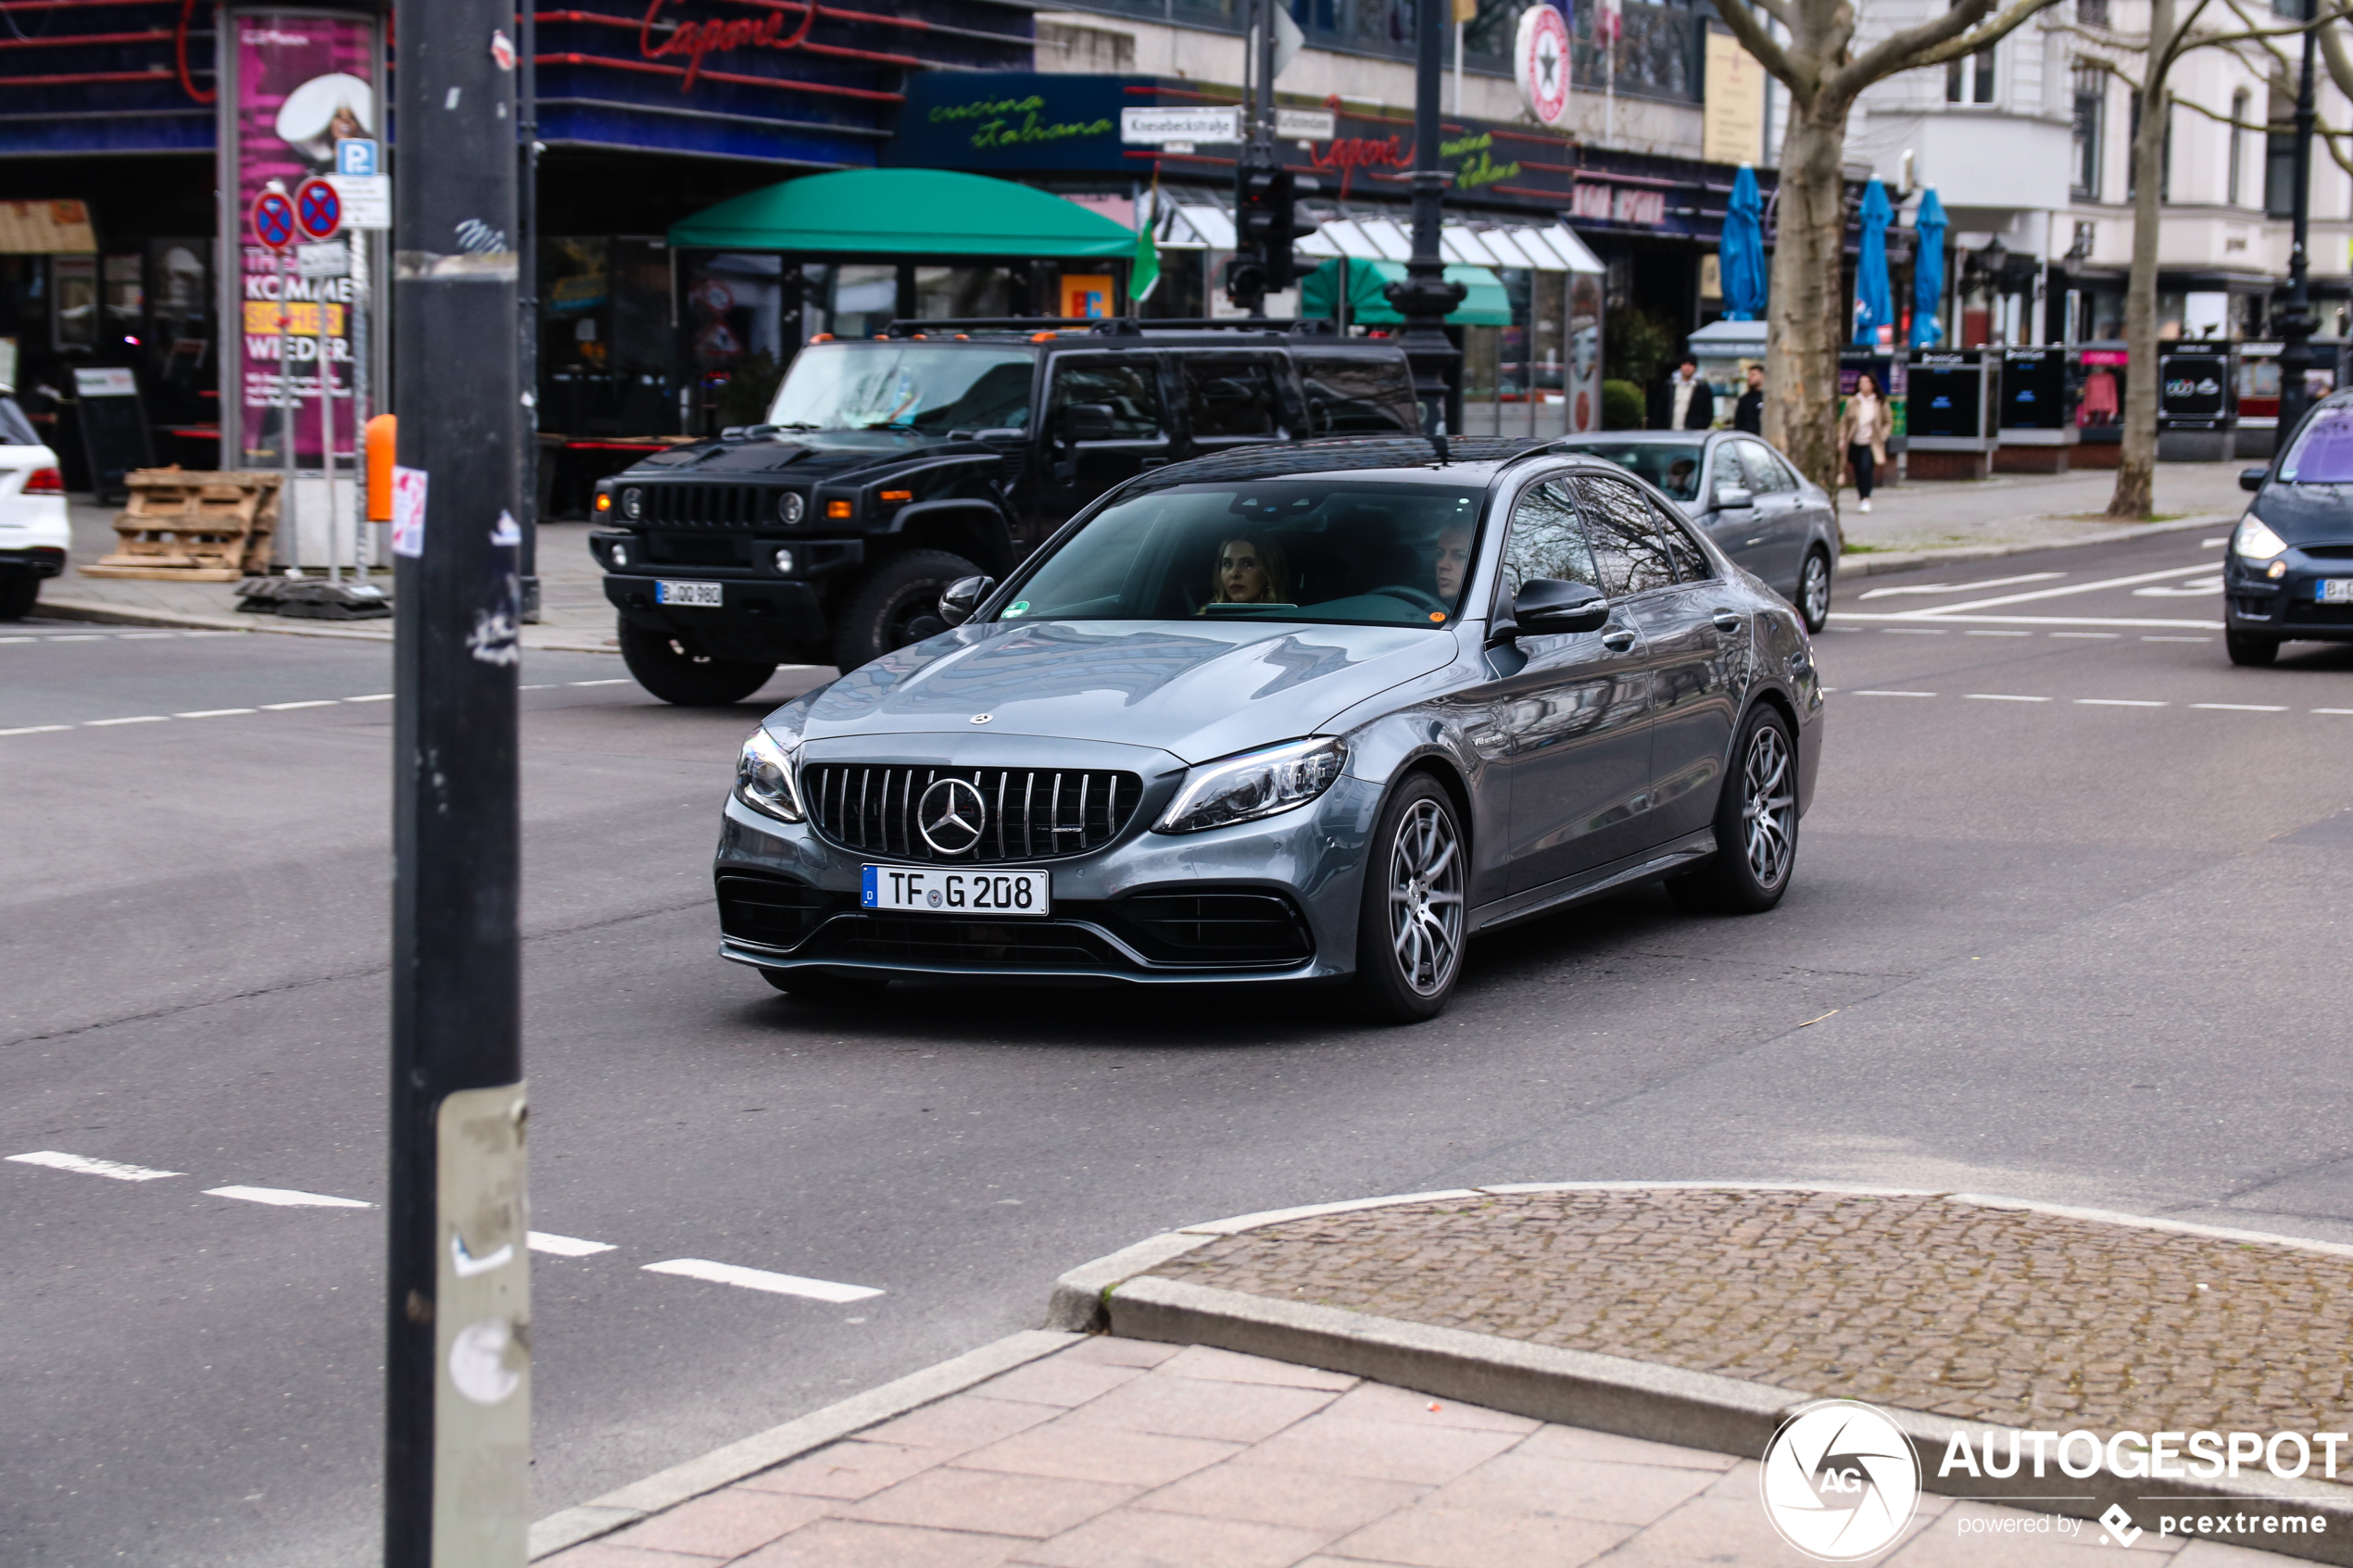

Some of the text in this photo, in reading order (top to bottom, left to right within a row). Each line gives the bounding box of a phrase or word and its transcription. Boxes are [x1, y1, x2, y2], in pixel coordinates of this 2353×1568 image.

[1130, 117, 1230, 134] Knesebeckstraße
[888, 872, 925, 905] TF
[946, 875, 965, 908] G
[973, 876, 1033, 909] 208
